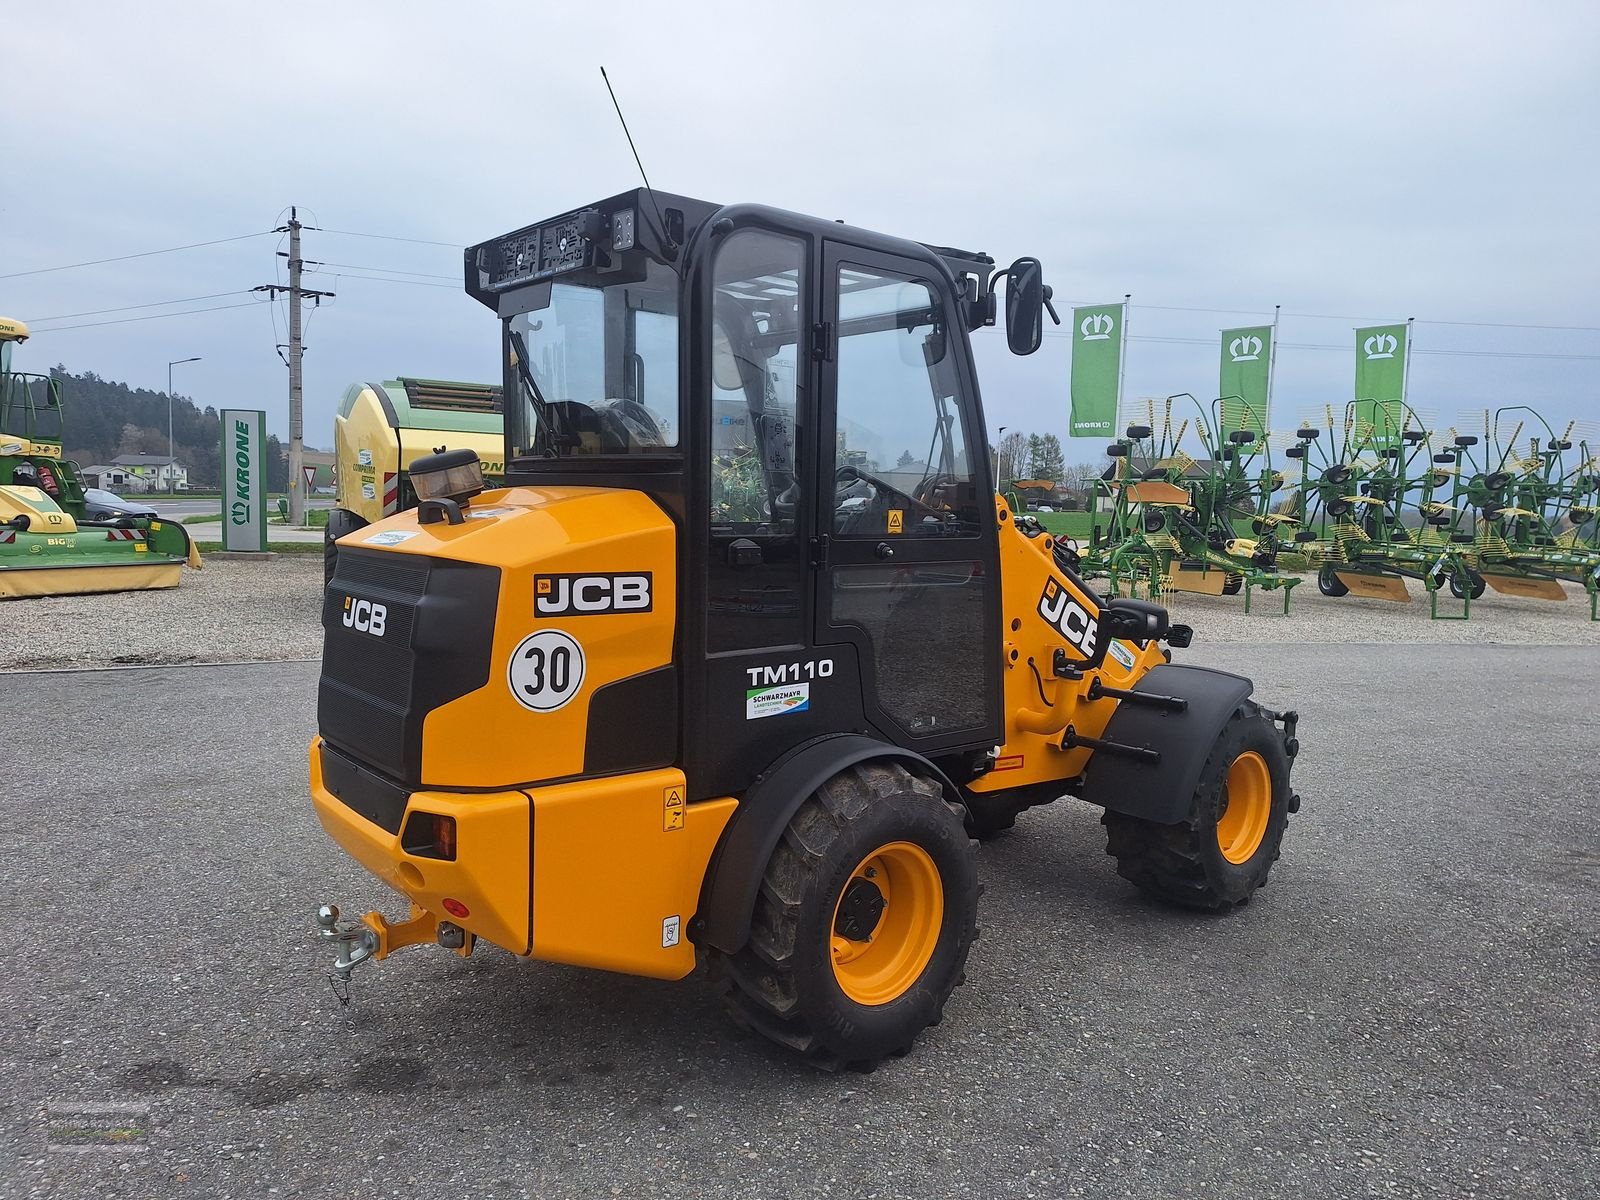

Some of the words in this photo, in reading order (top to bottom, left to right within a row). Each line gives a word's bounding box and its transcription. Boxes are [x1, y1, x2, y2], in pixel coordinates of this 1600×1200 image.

[235, 420, 250, 501] KRONE
[537, 576, 650, 613] JCB
[342, 596, 387, 637] JCB
[524, 646, 571, 696] 30
[746, 659, 834, 687] TM110
[753, 690, 801, 703] SCHWARZMAYR
[753, 700, 783, 709] LANDTECHNIK
